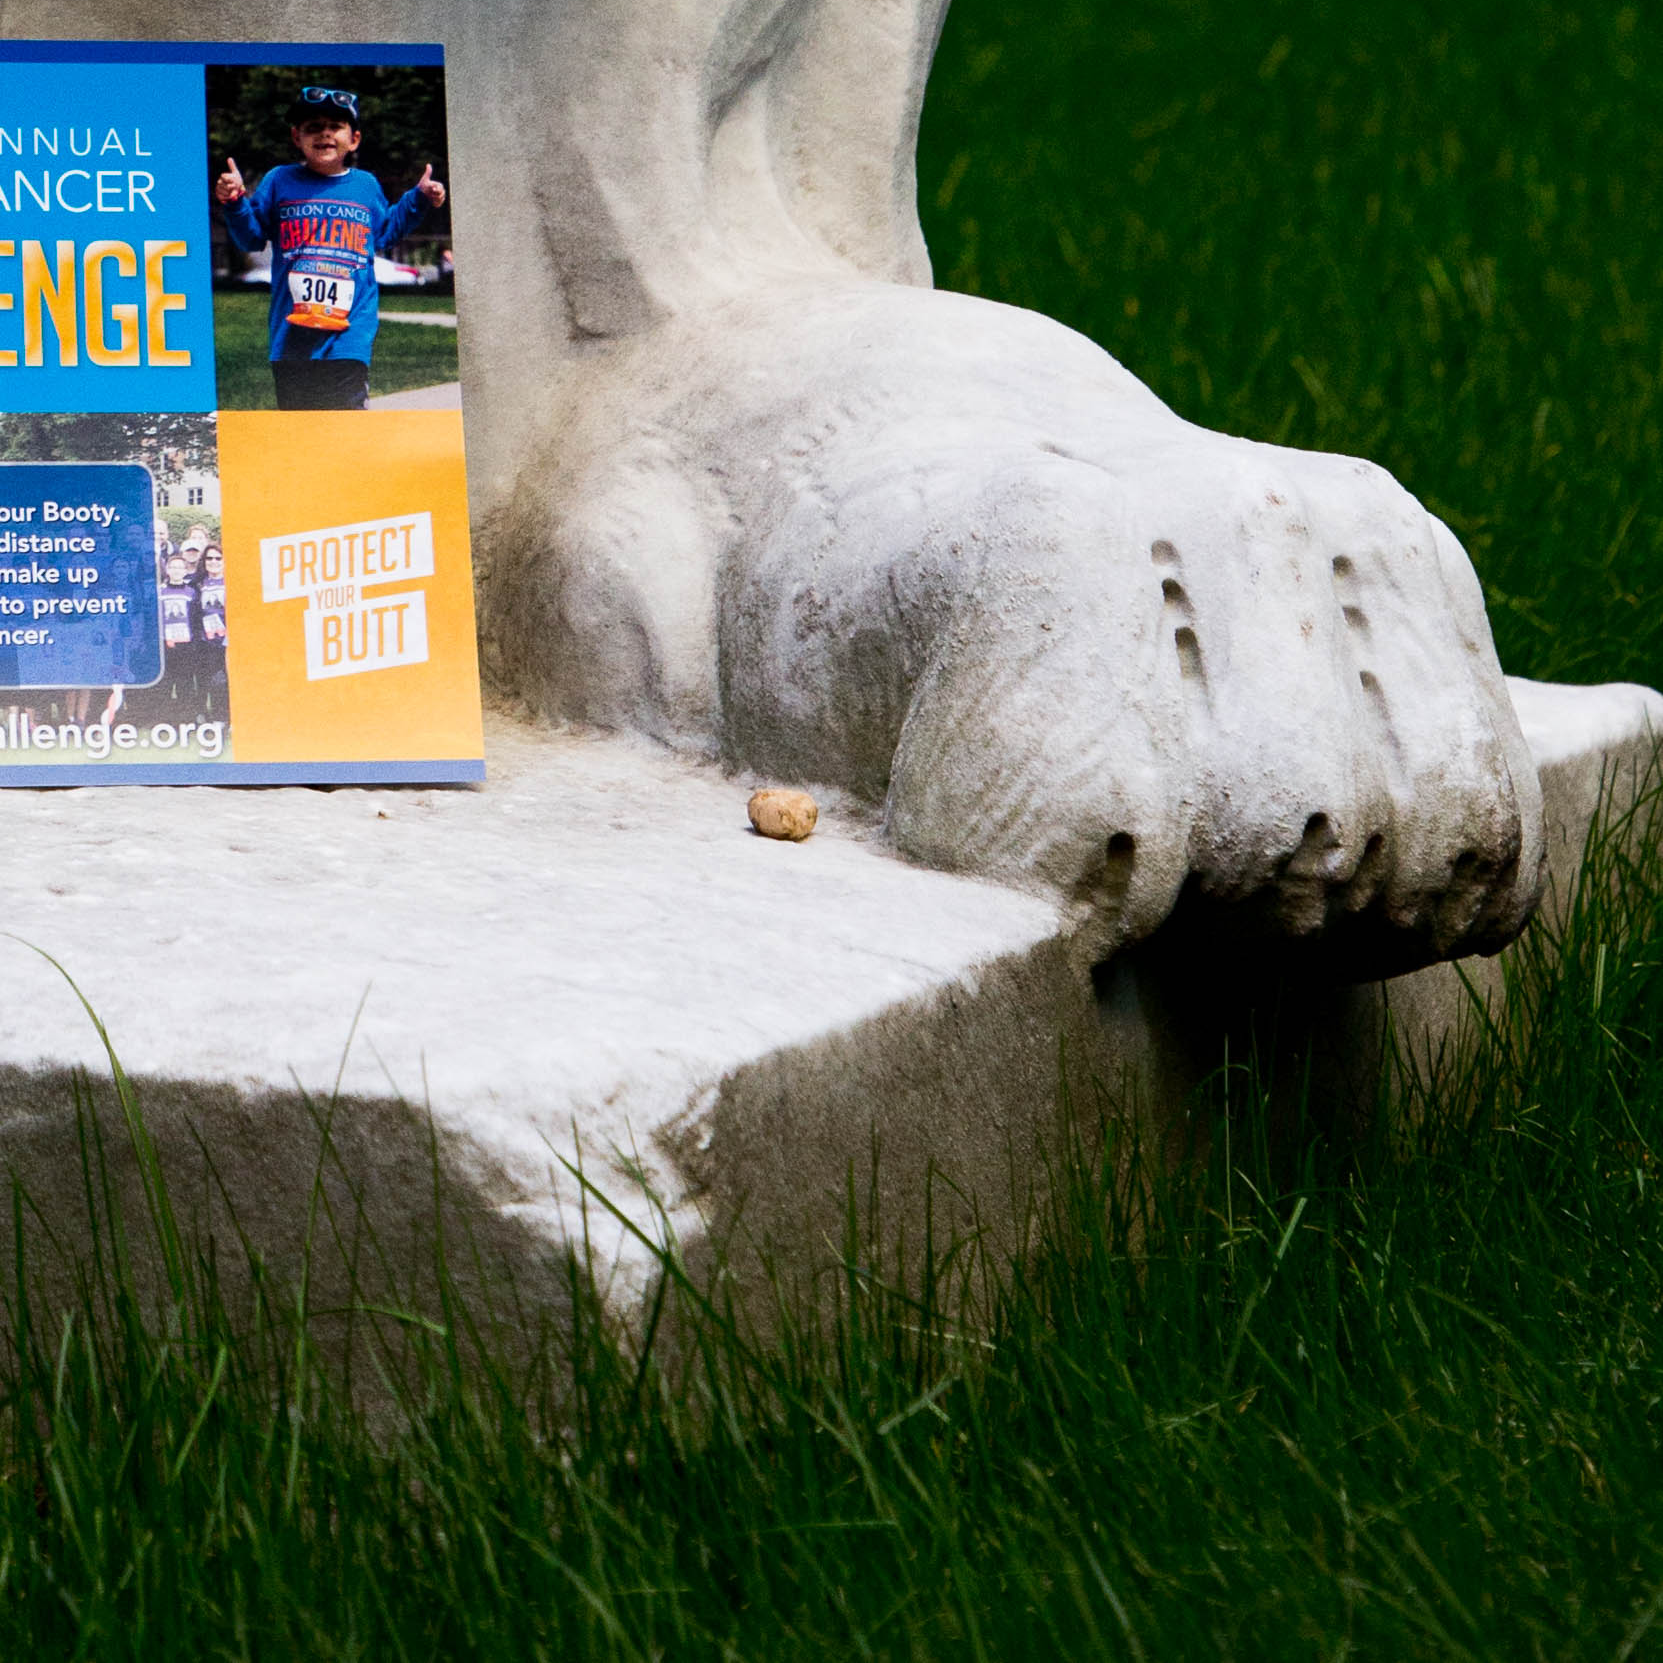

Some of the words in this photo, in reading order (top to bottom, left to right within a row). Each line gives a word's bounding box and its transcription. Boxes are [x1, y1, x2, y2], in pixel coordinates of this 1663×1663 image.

[280, 204, 324, 219] COLON
[302, 277, 338, 305] 304
[44, 501, 121, 528] Booty.
[277, 524, 416, 590] PROTECT
[67, 567, 99, 589] up
[32, 594, 127, 620] prevent
[315, 585, 355, 610] YOUR
[322, 603, 410, 667] BUTT
